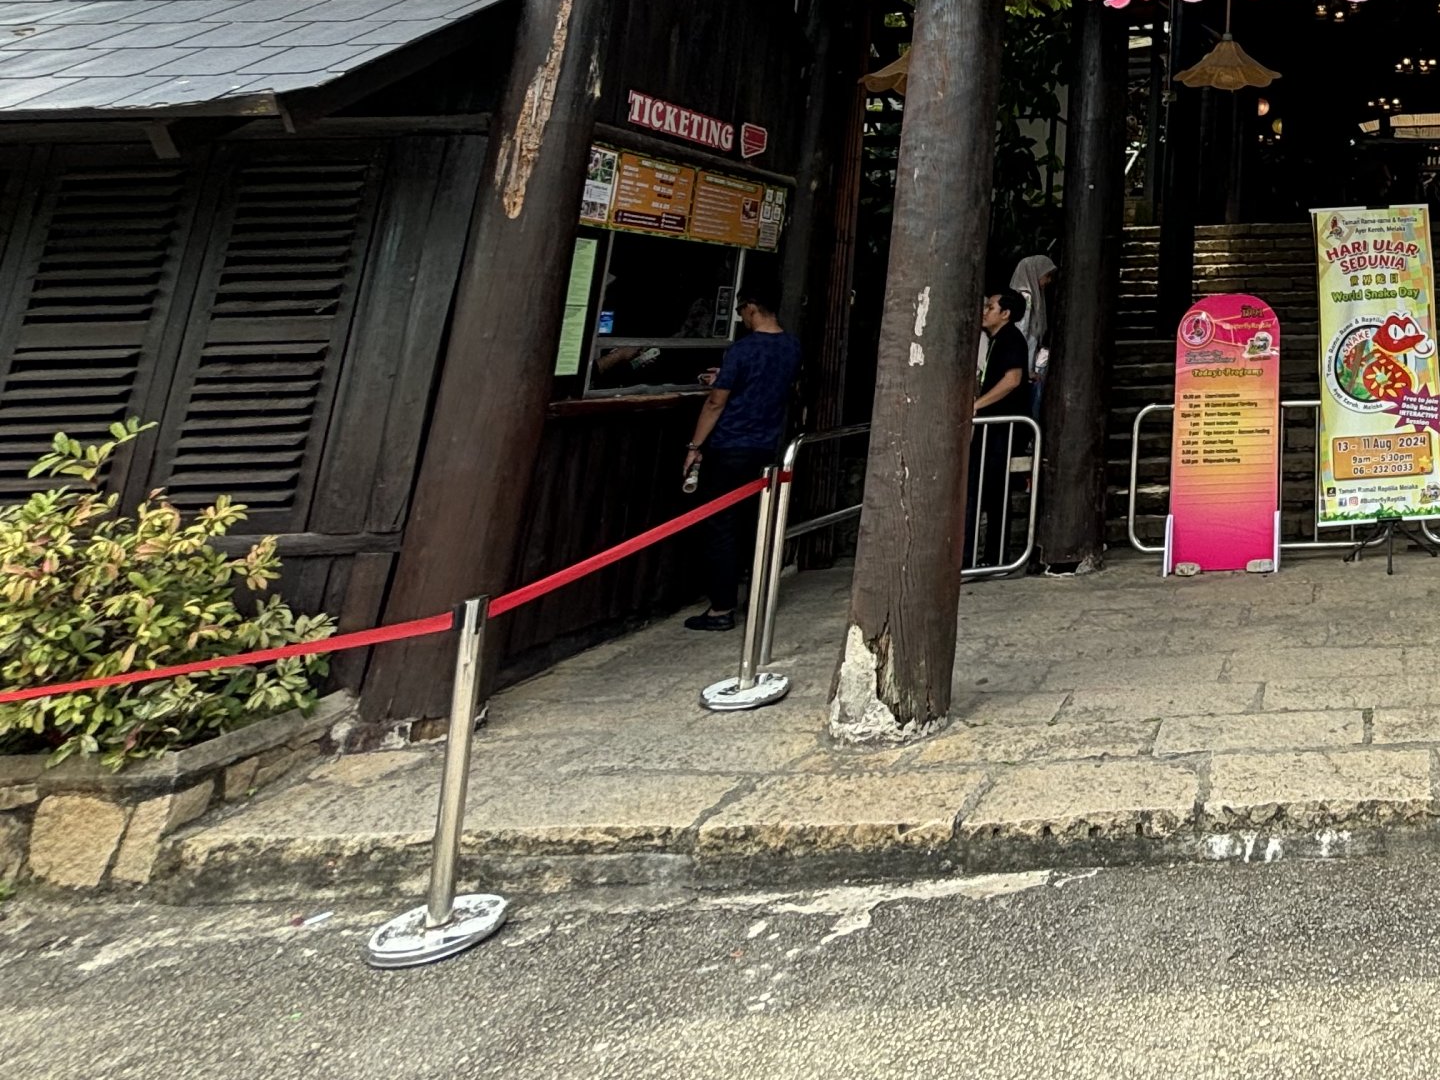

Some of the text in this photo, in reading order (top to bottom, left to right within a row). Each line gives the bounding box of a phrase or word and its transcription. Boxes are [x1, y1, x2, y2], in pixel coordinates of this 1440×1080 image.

[631, 92, 734, 150] TICKETING
[1326, 239, 1419, 262] HARI ULAR
[1340, 255, 1405, 272] SEDUNIA
[1331, 286, 1420, 302] World Snake Day
[1342, 330, 1370, 354] SNAKE
[1401, 402, 1439, 412] Daily Snake
[1337, 441, 1349, 452] 13
[1362, 438, 1370, 449] 11
[1372, 437, 1392, 452] Aug
[1398, 436, 1426, 448] 2024
[1353, 467, 1365, 475] 06
[1373, 465, 1389, 474] 232
[1390, 463, 1413, 472] 0033
